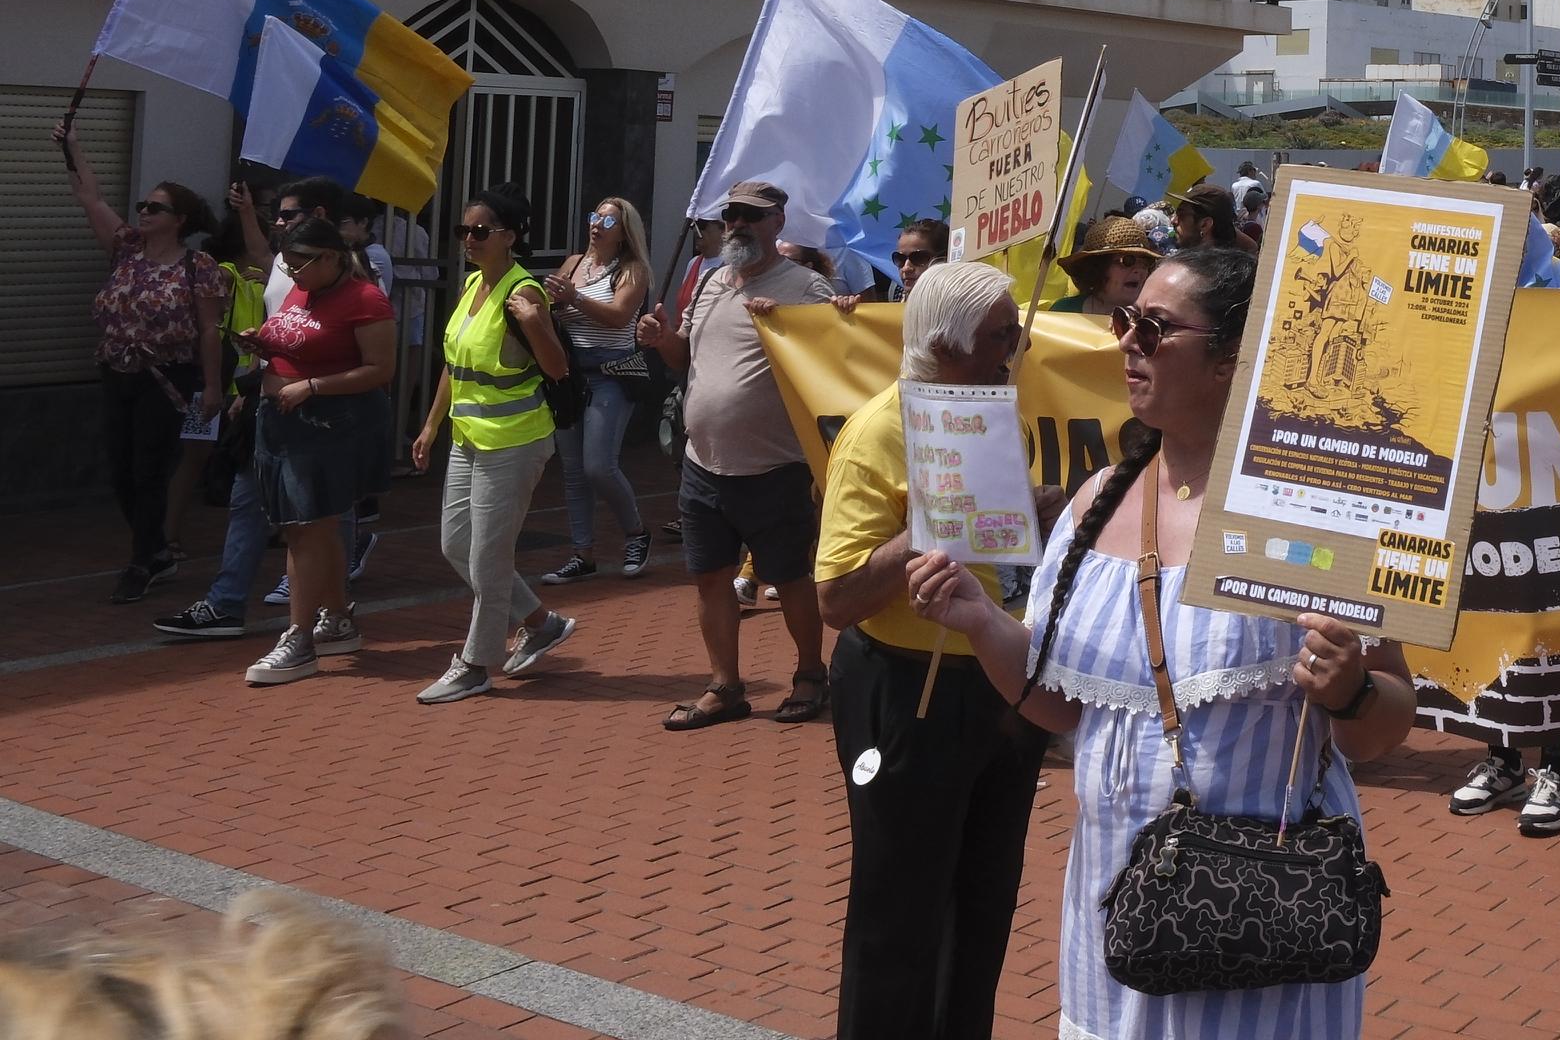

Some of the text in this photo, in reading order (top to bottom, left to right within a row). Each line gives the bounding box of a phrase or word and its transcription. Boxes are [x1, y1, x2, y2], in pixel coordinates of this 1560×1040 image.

[989, 143, 1032, 181] FUERA
[965, 161, 1045, 219] DE NUESTRO
[977, 190, 1043, 250] PUEBLO
[1410, 234, 1480, 257] CANARIAS
[1408, 251, 1478, 276] TIENE UN
[1404, 266, 1474, 300] LÍMITE
[1430, 298, 1453, 307] OCTUBRE
[1272, 429, 1428, 468] ¡POR UN CAMBIO DE MODELO!
[1306, 477, 1321, 485] PERO
[1347, 484, 1361, 493] CERO
[1380, 531, 1451, 560] CANARIAS
[1377, 550, 1449, 579] TIENE UN
[1220, 579, 1379, 622] ¡POR UN CAMBIO DE MODELO!
[1371, 566, 1445, 606] LÍMITE
